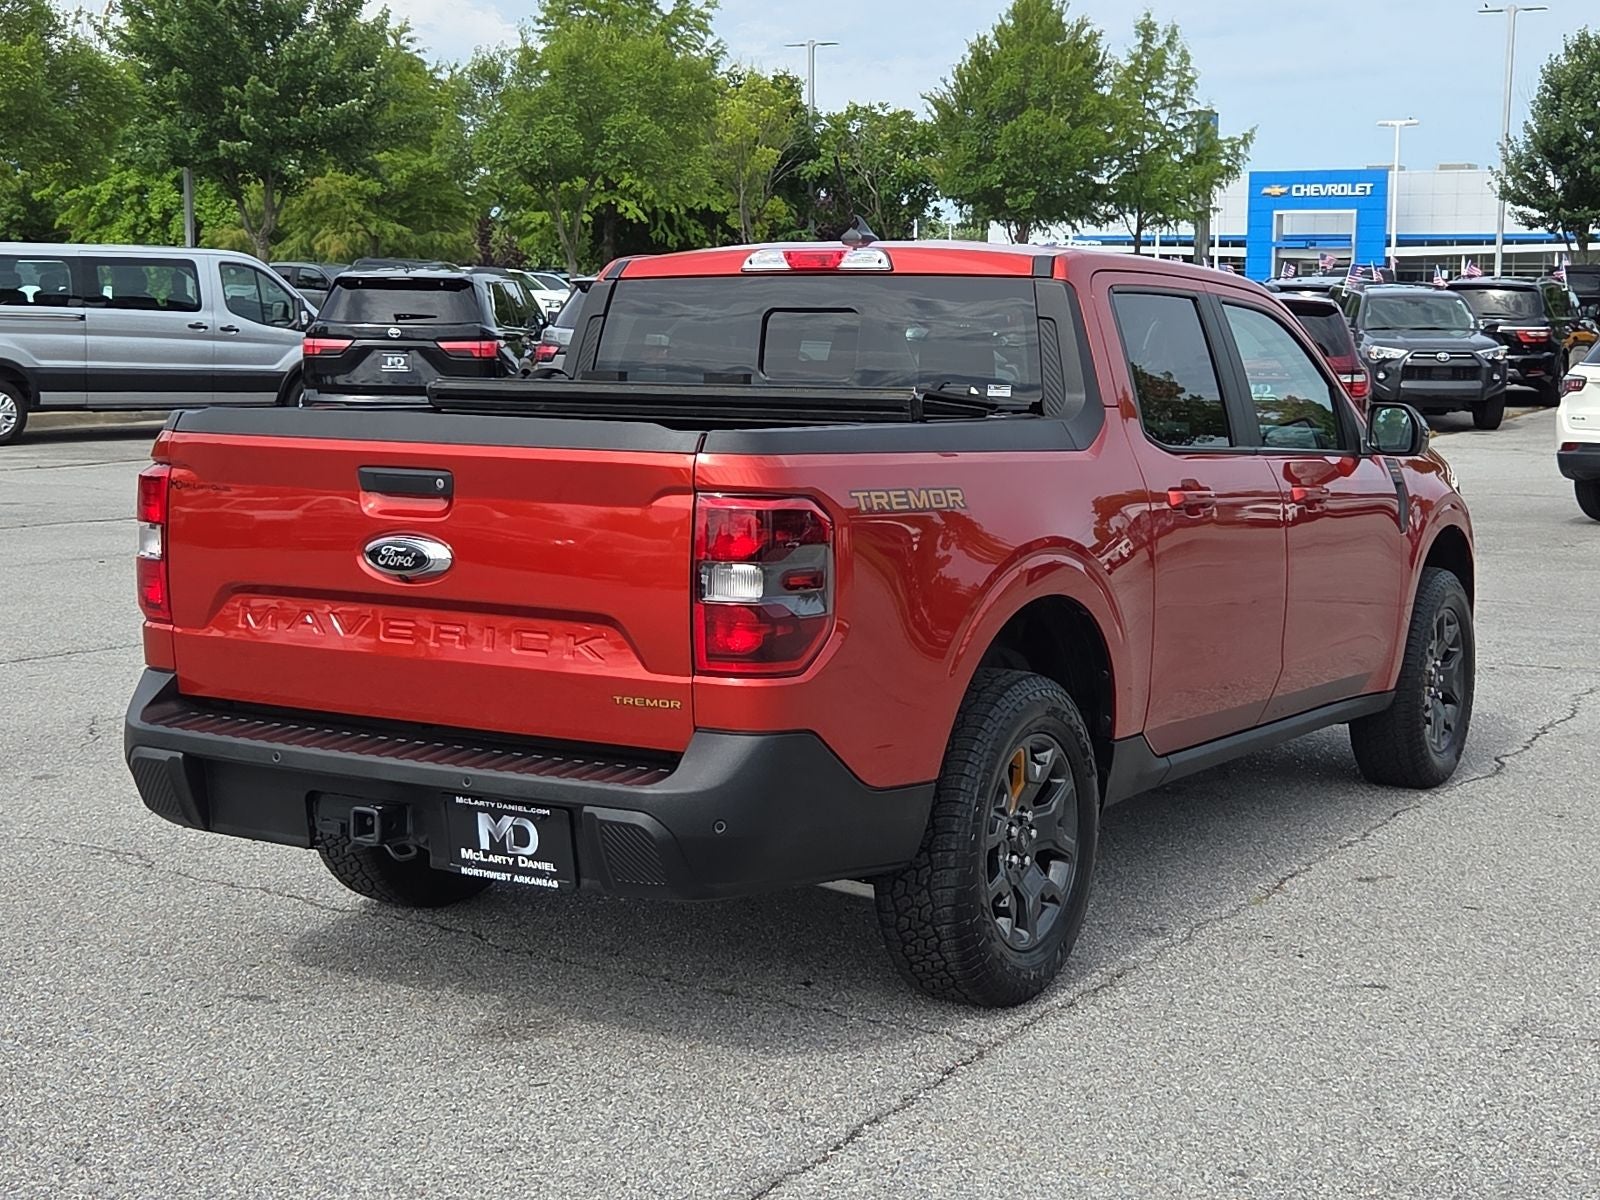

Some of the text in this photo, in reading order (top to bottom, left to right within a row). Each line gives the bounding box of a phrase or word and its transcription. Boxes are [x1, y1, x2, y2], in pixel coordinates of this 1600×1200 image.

[1291, 183, 1374, 197] CHEVROLET
[849, 488, 967, 512] TREMOR
[377, 545, 417, 567] Ford
[238, 605, 608, 664] MAVERICK
[612, 695, 682, 710] TREMOR
[477, 811, 539, 856] MD
[461, 867, 559, 889] NORTHWEST ARKANSAS
